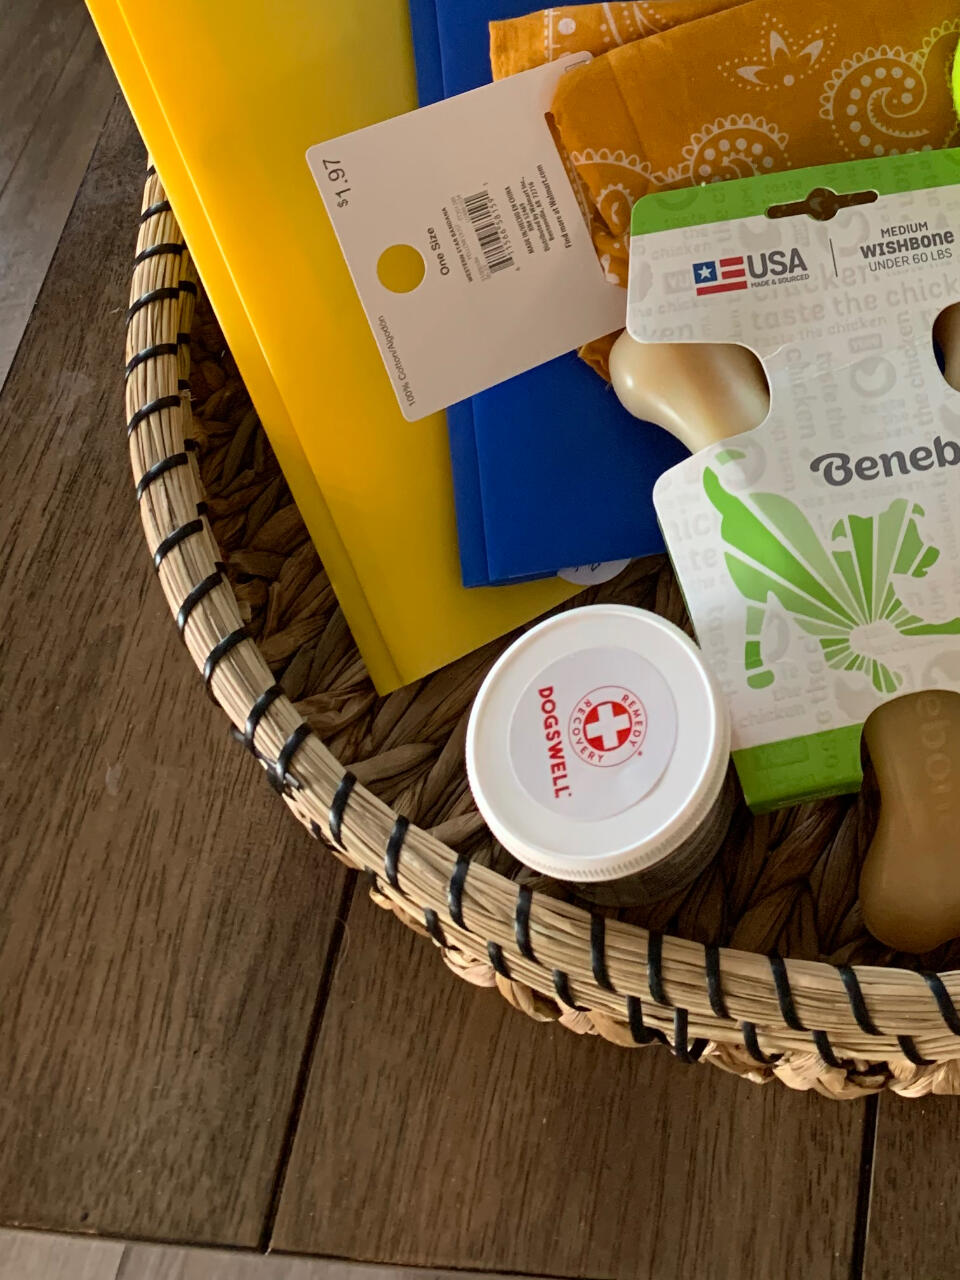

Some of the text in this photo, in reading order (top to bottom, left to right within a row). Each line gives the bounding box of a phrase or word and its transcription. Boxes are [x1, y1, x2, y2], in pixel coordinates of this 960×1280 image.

[323, 158, 352, 208] $1.97
[536, 163, 573, 249] Find more at Walmart.com
[426, 226, 450, 276] One Size
[880, 221, 928, 239] MEDIUM
[747, 247, 808, 280] USA
[751, 281, 771, 289] MADE
[777, 273, 810, 285] SOURCED
[868, 247, 953, 273] UNDER 60 LBS
[400, 380, 416, 407] 100%
[538, 685, 570, 799] DOGSWELL
[572, 699, 604, 762] RECOVERY
[621, 694, 643, 747] REMEDY
